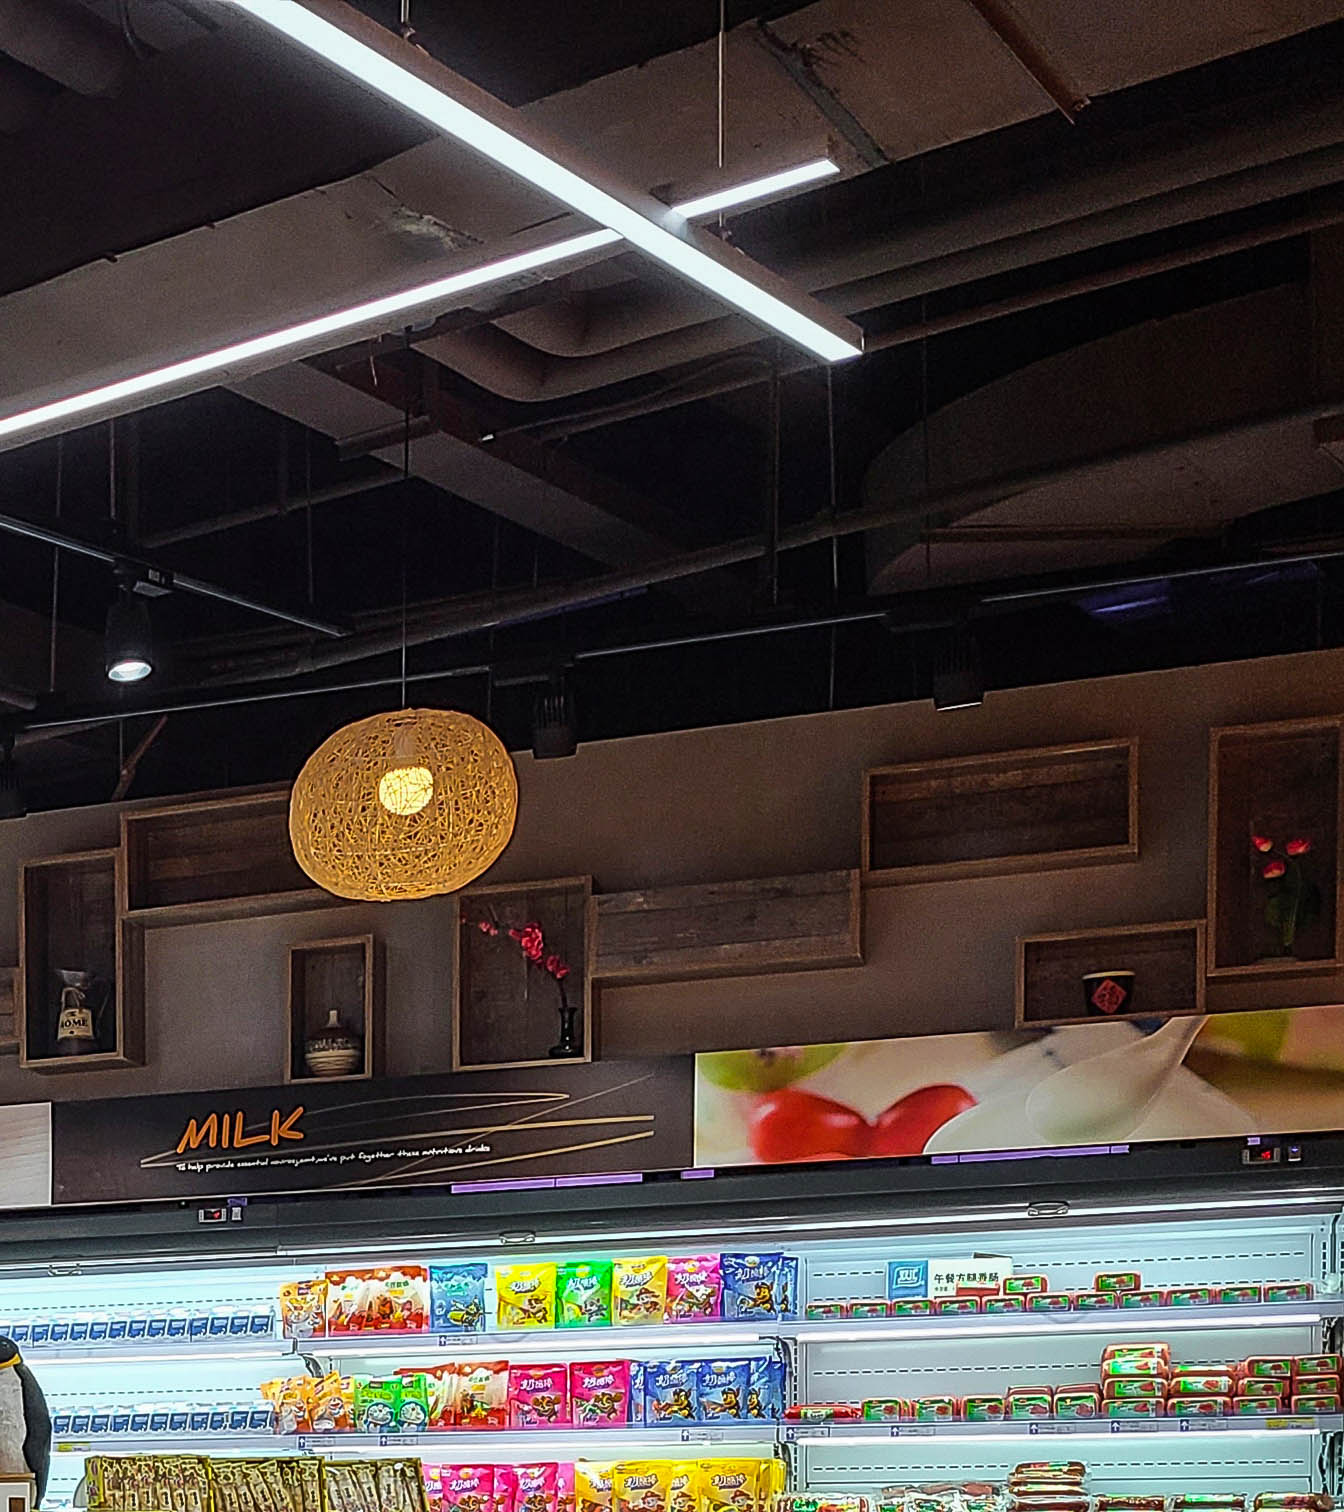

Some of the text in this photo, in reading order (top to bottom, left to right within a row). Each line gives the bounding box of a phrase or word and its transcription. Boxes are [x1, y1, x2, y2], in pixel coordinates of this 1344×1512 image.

[175, 1106, 305, 1154] MILK
[206, 1160, 234, 1172] provide
[340, 1153, 355, 1164] put
